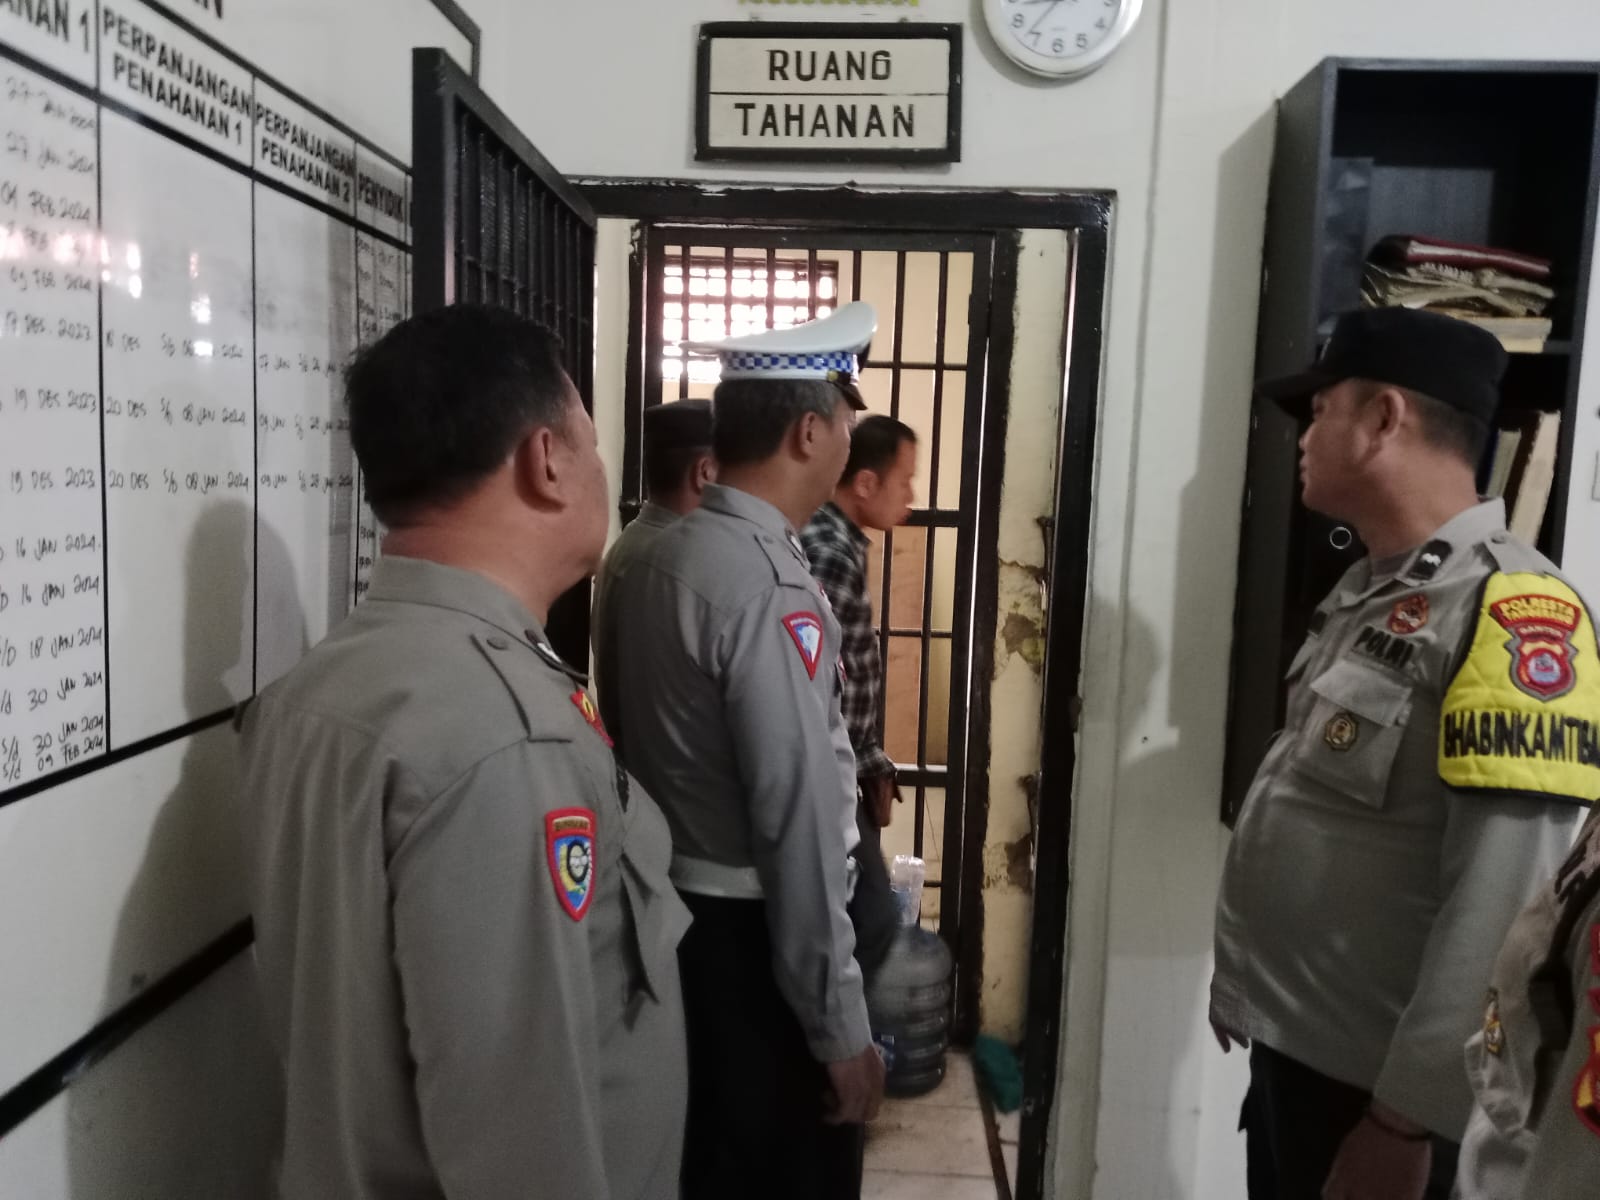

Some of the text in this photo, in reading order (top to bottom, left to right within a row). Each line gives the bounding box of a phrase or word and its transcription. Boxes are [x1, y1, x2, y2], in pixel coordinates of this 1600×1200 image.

[79, 9, 90, 54] 1
[1011, 13, 1024, 28] 8
[103, 6, 252, 118] PERPANJANGAN
[1052, 38, 1064, 53] 6
[766, 49, 892, 82] RUANG
[113, 52, 230, 139] PENAHANAN
[234, 119, 242, 145] 1
[733, 102, 916, 138] TAHANAN
[256, 102, 356, 177] PERPANJANGAN
[261, 136, 341, 198] PENAHANAN
[64, 466, 96, 490] 2023
[108, 469, 124, 489] 20
[34, 537, 58, 561] JAN
[73, 574, 100, 596] 2024
[50, 634, 74, 659] JAN
[77, 625, 103, 648] 2024
[27, 688, 48, 712] 30
[57, 677, 76, 701] JAN
[33, 732, 53, 758] 30
[58, 721, 78, 744] JAN
[81, 714, 105, 733] 2024
